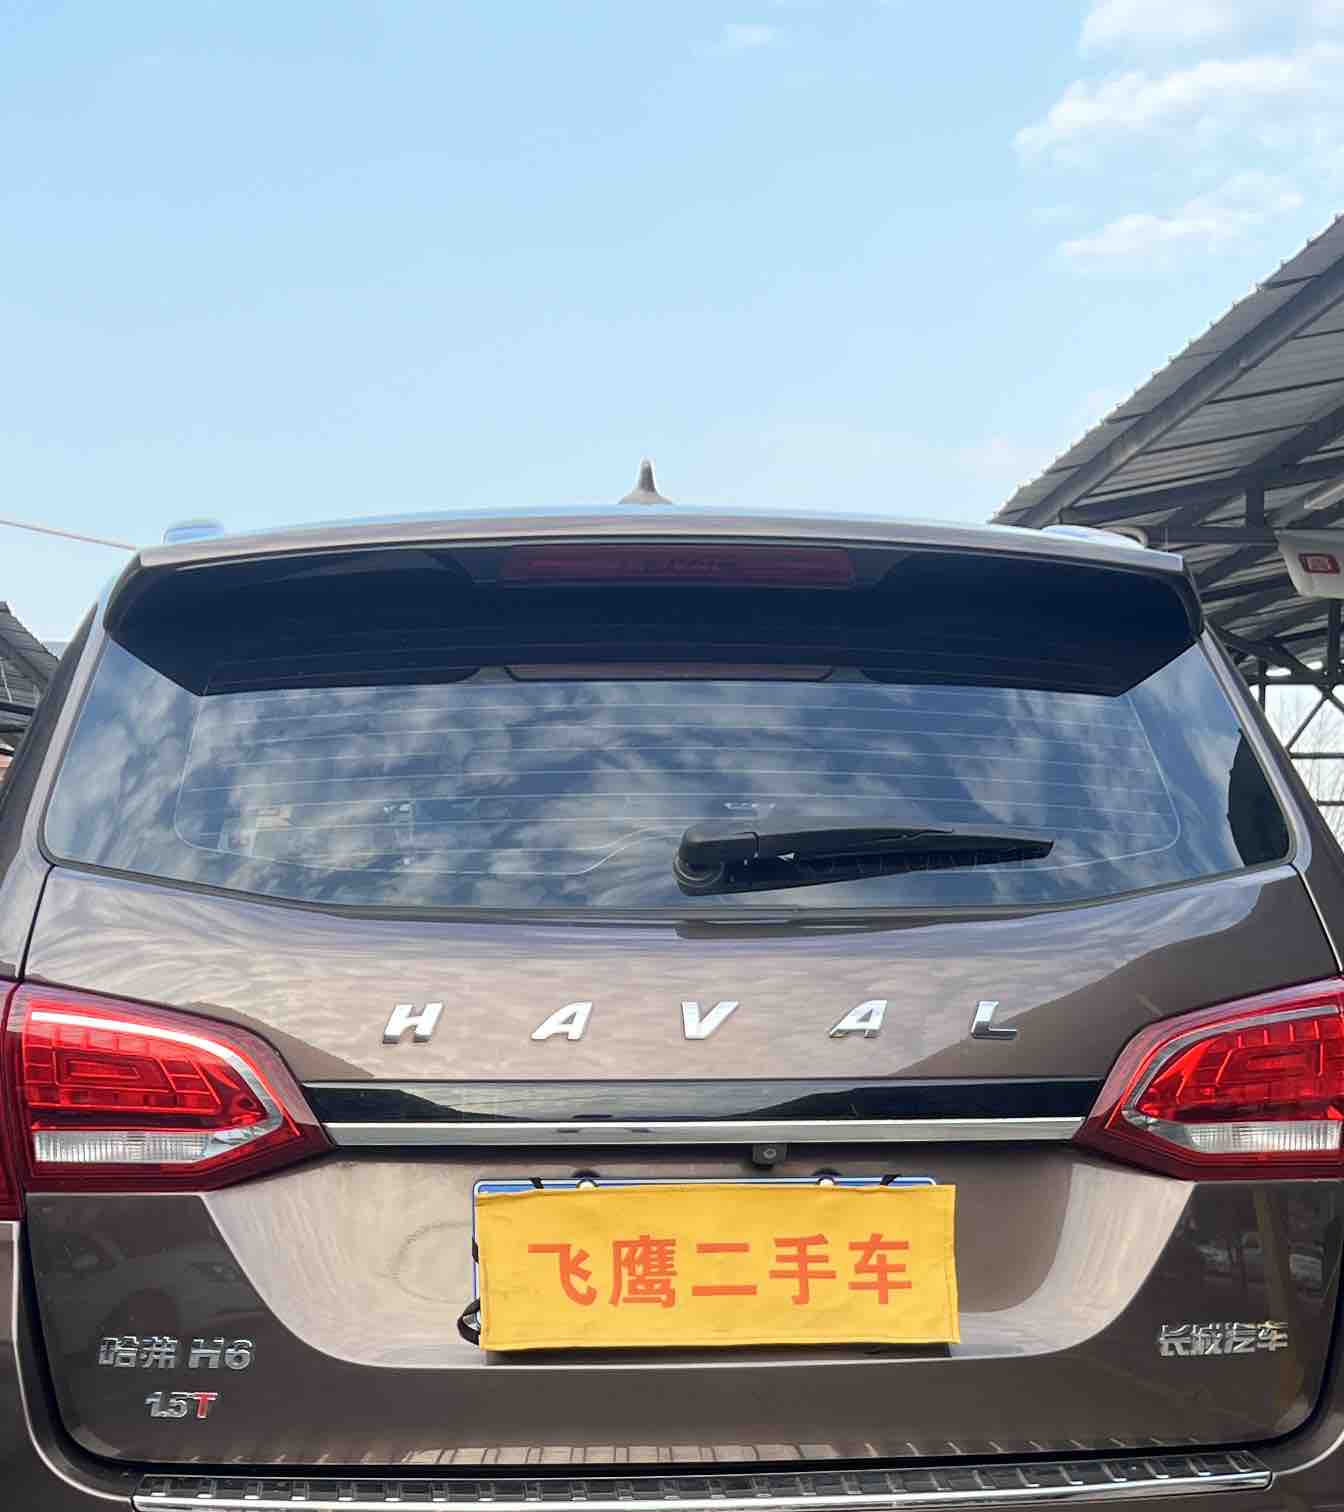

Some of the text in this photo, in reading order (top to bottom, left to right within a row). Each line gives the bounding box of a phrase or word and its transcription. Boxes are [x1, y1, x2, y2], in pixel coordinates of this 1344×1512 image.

[382, 1000, 1019, 1045] HAVAL
[527, 1233, 913, 1308] 飞鹰二手车
[98, 1335, 253, 1370] 哈弗 H6
